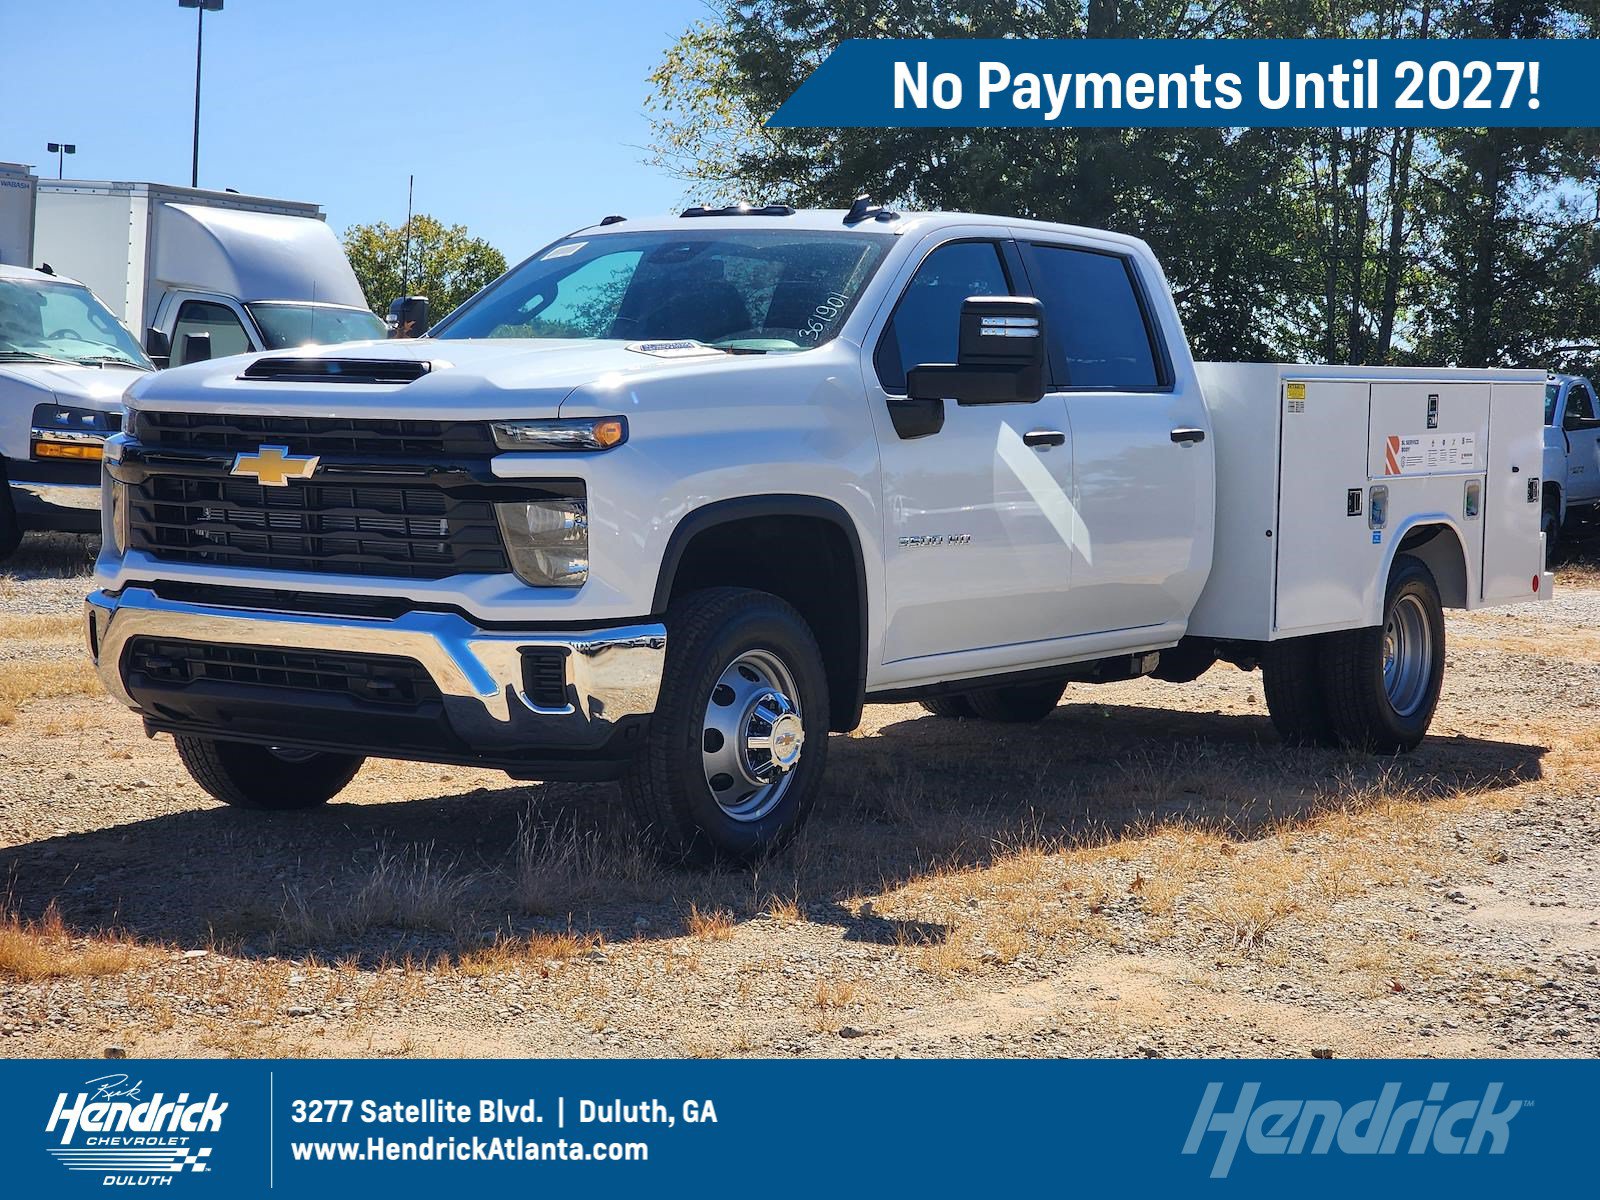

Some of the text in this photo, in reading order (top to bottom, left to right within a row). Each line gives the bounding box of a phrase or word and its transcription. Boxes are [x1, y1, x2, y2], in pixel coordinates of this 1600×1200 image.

[1, 181, 30, 189] WABASH
[799, 291, 850, 340] 361901
[948, 533, 971, 546] HD
